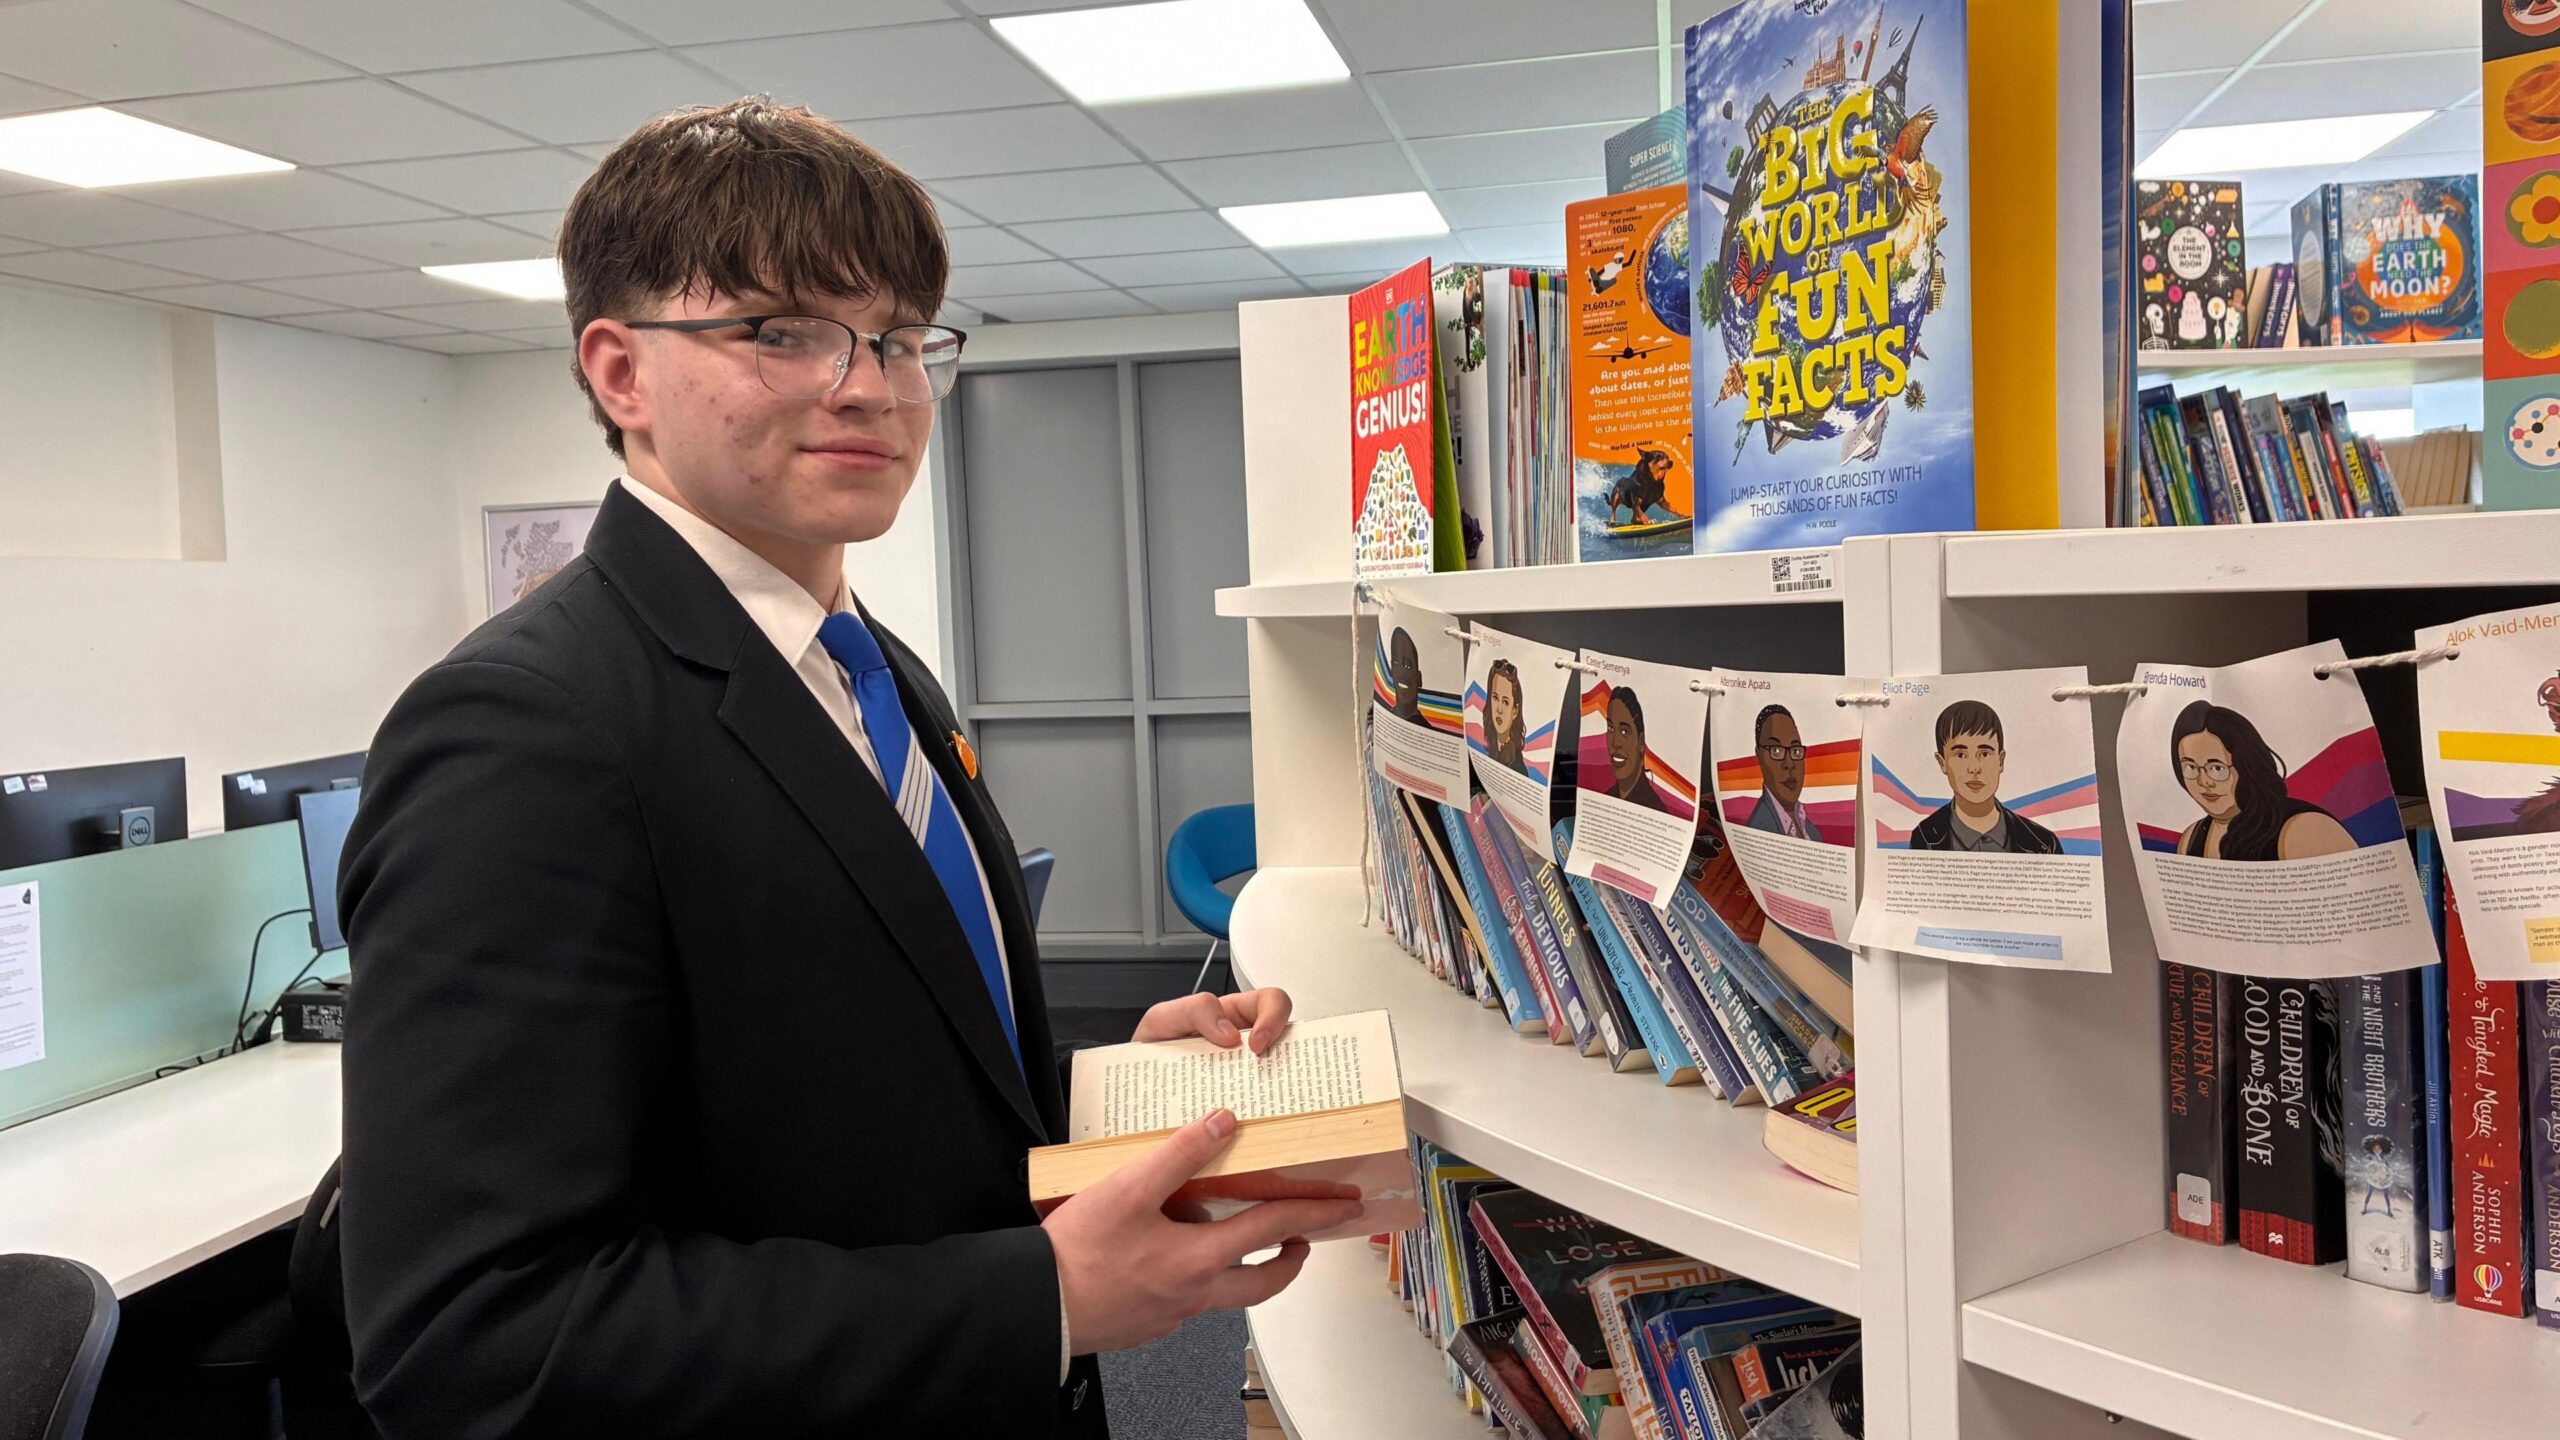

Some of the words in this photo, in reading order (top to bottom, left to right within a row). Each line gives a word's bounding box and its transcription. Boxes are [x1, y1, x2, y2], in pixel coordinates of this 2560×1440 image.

[1796, 97, 1831, 125] THE
[1629, 150, 1648, 168] SUPER
[1649, 139, 1674, 160] SCIENCE
[1760, 88, 1879, 207] BIG
[1612, 223, 1636, 235] 1080,
[1740, 170, 1904, 267] WORLD
[2371, 212, 2446, 242] WHY
[1591, 245, 1624, 254] skateboard
[2415, 241, 2431, 249] THE
[1807, 249, 1830, 272] OF
[2179, 260, 2202, 268] ROOM
[2372, 249, 2447, 272] EARTH
[2387, 270, 2411, 278] NEED
[1753, 240, 1895, 356] FUN
[2369, 276, 2452, 300] MOON?
[1583, 300, 1614, 312] 21,601.7
[2418, 308, 2443, 316] PLANET
[1354, 294, 1426, 368] EARTH
[1355, 349, 1426, 397] KNOWLEDGE
[1590, 384, 1618, 395] about
[1621, 381, 1651, 391] dates,
[1654, 379, 1665, 387] or
[1668, 375, 1689, 387] just
[1601, 371, 1618, 380] Are
[1621, 369, 1640, 379] you
[1643, 364, 1665, 374] mad
[1668, 362, 1692, 371] abou
[1743, 325, 1908, 422] FACTS
[1356, 381, 1426, 438] GENIUS!
[1588, 412, 1614, 421] behind
[1616, 410, 1637, 419] every
[1640, 407, 1658, 416] topic
[1661, 403, 1683, 411] under
[1594, 399, 1612, 408] Then
[1647, 390, 1686, 401] incredible
[1595, 425, 1603, 433] in
[1605, 424, 1617, 432] the
[1620, 422, 1653, 431] Universe
[1667, 418, 1680, 426] the
[1730, 480, 1791, 504] JUMP-START
[1793, 477, 1824, 493] YOUR
[1826, 470, 1886, 491] CURIOSITY
[1889, 465, 1922, 483] WITH
[1750, 497, 1815, 518] THOUSANDS
[1817, 495, 1832, 511] OF
[1835, 494, 1857, 510] FUN
[1860, 490, 1898, 507] FACTS!
[1819, 520, 1837, 529] POOLE
[2446, 627, 2476, 646] Alok
[1586, 655, 1601, 671] Caster
[1602, 660, 1631, 676] Semenya
[2143, 671, 2167, 686] Brenda
[2169, 673, 2206, 688] Howard
[1748, 679, 1771, 692] Apata
[1882, 682, 1902, 696] Elliot
[1905, 681, 1930, 695] Page
[2527, 843, 2548, 852] gender
[2512, 868, 2547, 877] authenticity
[2524, 860, 2544, 868] poetry
[1536, 861, 1577, 947] TUNNELS
[1604, 900, 1627, 934] JACKSON
[1624, 893, 1644, 921] JOELS
[1675, 885, 1707, 923] ROP
[1520, 875, 1537, 914] Truly
[1532, 911, 1570, 988] DEVIOUS
[1642, 920, 1663, 955] PENNY
[1476, 904, 1493, 938] TOM
[1490, 944, 1508, 992] HOYL
[1597, 922, 1626, 979] UNLADYLIKE
[1624, 934, 1642, 962] HOLLY
[2168, 963, 2184, 999] RTUE
[2362, 984, 2371, 1001] THE
[2372, 984, 2382, 1004] AND
[1669, 969, 1702, 1024] SECRETS
[2244, 975, 2271, 1046] OOD
[2546, 980, 2560, 1017] ouse
[1625, 983, 1641, 1014] ROBIN
[1640, 1015, 1660, 1053] STEVENS
[1719, 974, 1736, 999] THE
[1728, 994, 1751, 1033] FIVE
[1747, 1028, 1779, 1082] CLUES
[2192, 972, 2216, 1080] CHILDREN
[2362, 1006, 2384, 1050] NIGHT
[1699, 1024, 1714, 1046] NO
[2278, 988, 2306, 1109] CHILDREN
[2466, 1007, 2504, 1079] Tangled
[1711, 1046, 1731, 1081] HAVE
[2170, 1019, 2188, 1117] VENGEANCE
[2249, 1048, 2265, 1077] AND
[2362, 1053, 2387, 1128] BROTHERS
[2241, 1074, 2279, 1166] BONE
[2286, 1109, 2300, 1129] OF
[2466, 1082, 2499, 1140] Magic
[2187, 1195, 2204, 1204] ADE
[2472, 1170, 2486, 1255] ANDERSON
[2488, 1188, 2501, 1244] SOPHIE
[2547, 1185, 2560, 1270] ANDERSON
[1545, 1240, 1642, 1265] LOSE
[2374, 1246, 2391, 1257] ALS
[2433, 1240, 2443, 1260] ATK
[1480, 1248, 1494, 1316] EXQUISIT
[2474, 1296, 2502, 1307] USBORNE
[1598, 1291, 1621, 1352] RUNNING
[1620, 1360, 1635, 1396] GIRL
[1754, 1334, 1768, 1342] The
[1460, 1343, 1474, 1367] The
[1521, 1338, 1550, 1378] BLOOD
[1552, 1385, 1586, 1434] POISON
[1689, 1348, 1698, 1365] THE
[1694, 1365, 1716, 1418] CLOCKWORK
[1713, 1419, 1727, 1440] SPAR
